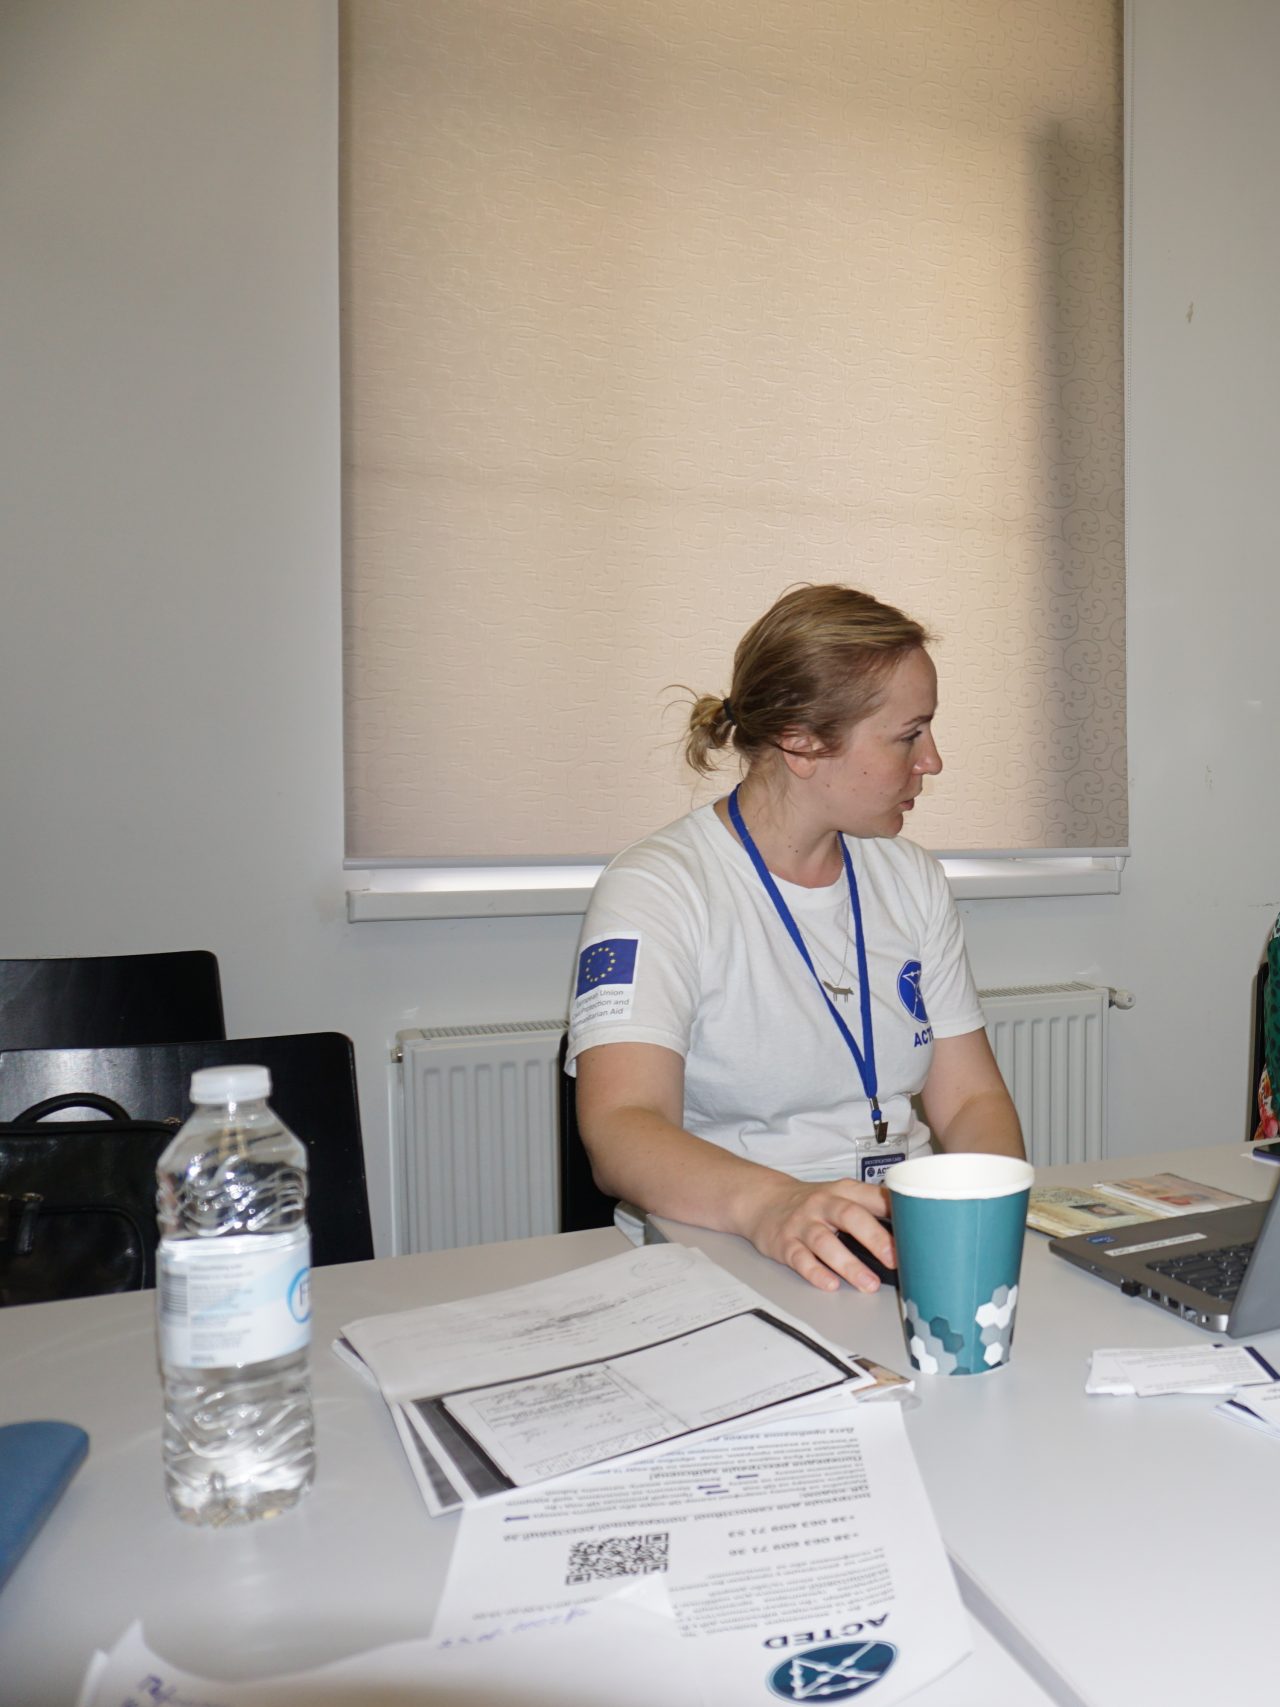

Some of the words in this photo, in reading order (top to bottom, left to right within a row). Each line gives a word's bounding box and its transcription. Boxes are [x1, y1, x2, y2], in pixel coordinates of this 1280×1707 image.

[599, 989, 624, 997] Union
[914, 1027, 934, 1048] ACT
[762, 1611, 891, 1650] ACTED
